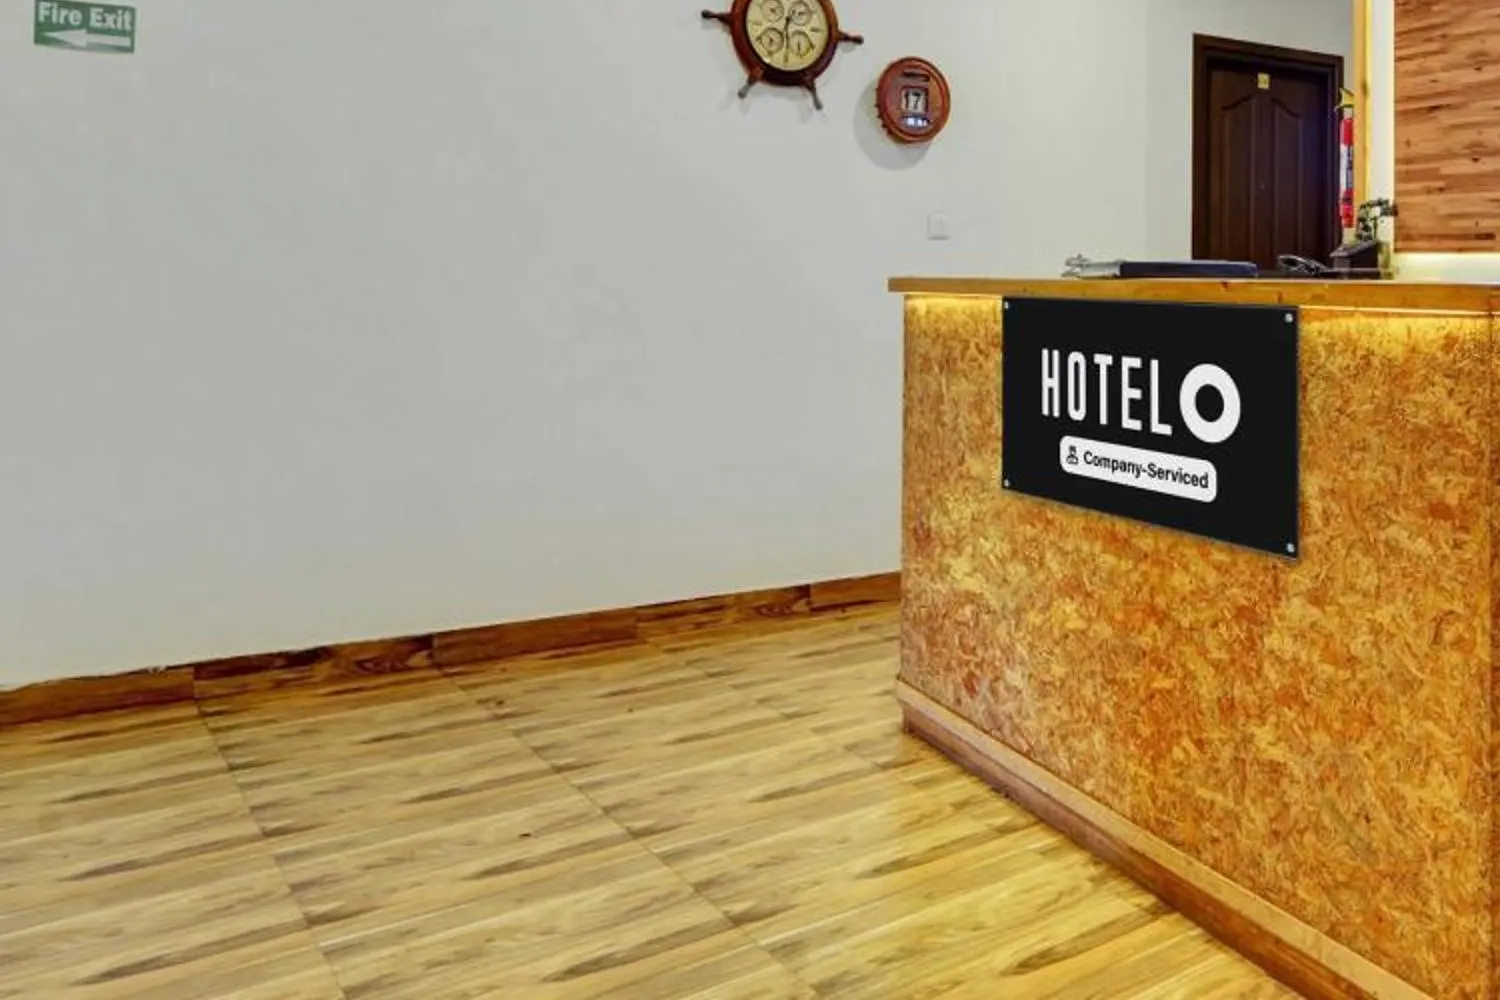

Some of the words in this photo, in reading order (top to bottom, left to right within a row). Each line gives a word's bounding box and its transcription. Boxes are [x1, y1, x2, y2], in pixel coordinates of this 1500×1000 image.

[38, 1, 83, 25] Fire
[89, 7, 131, 30] Exit
[1041, 348, 1173, 436] HOTEL
[1083, 451, 1209, 488] Company-Serviced
